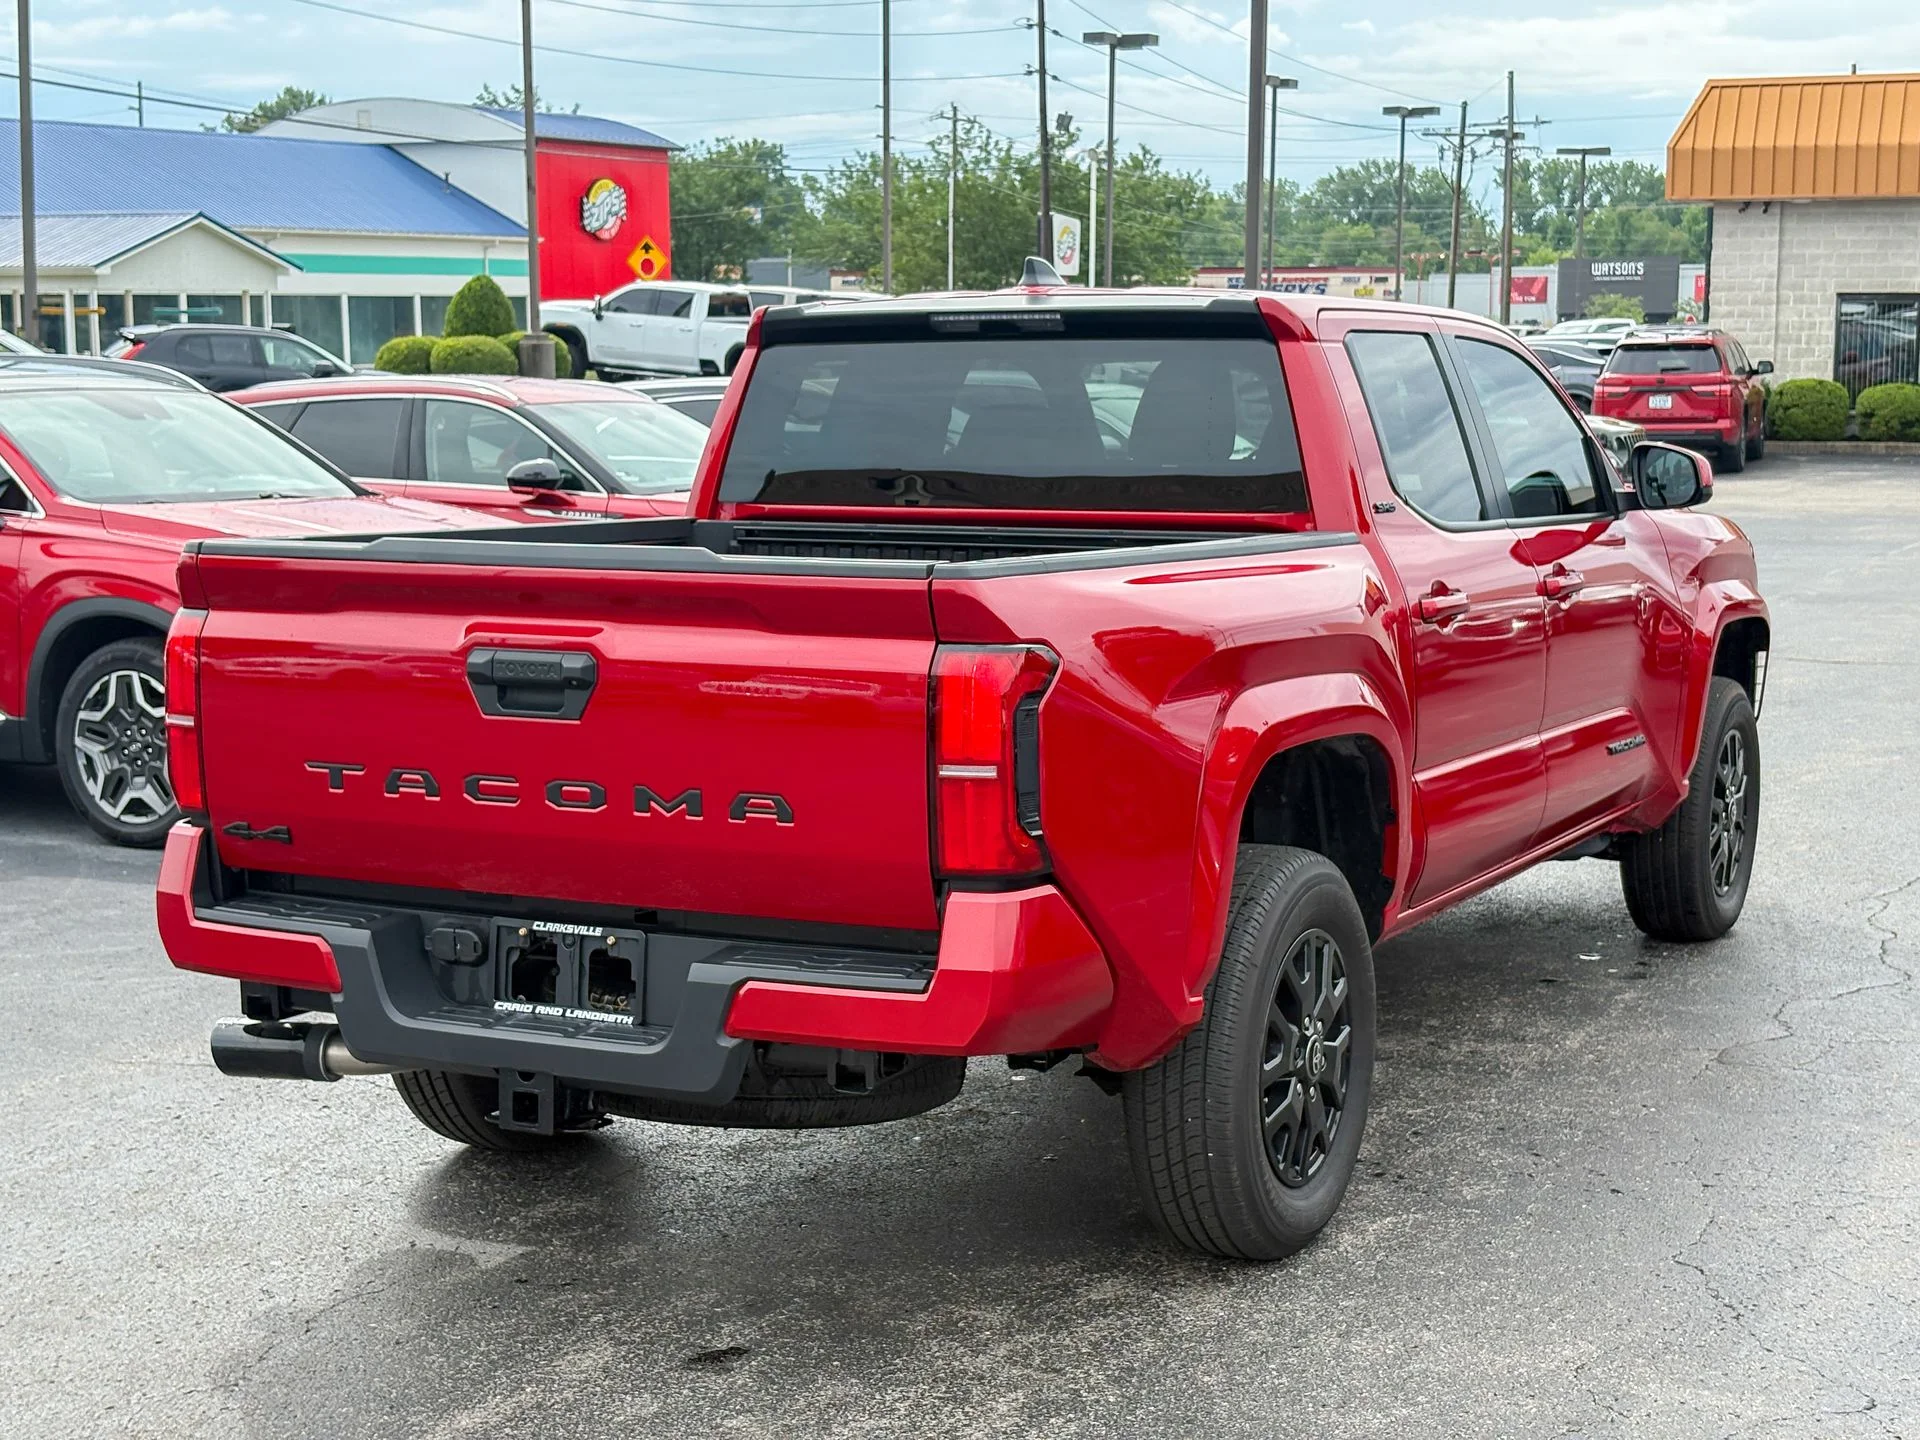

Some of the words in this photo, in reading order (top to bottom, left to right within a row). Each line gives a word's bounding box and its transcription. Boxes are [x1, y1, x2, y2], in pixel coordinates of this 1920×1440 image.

[590, 187, 621, 228] ZIPS
[1591, 261, 1644, 276] WATSON'S
[495, 661, 558, 679] TOYOTA
[1606, 734, 1646, 756] TACOMA
[304, 760, 795, 827] TACOMA
[532, 921, 603, 937] CLARKSVILLE
[535, 1004, 563, 1017] AND
